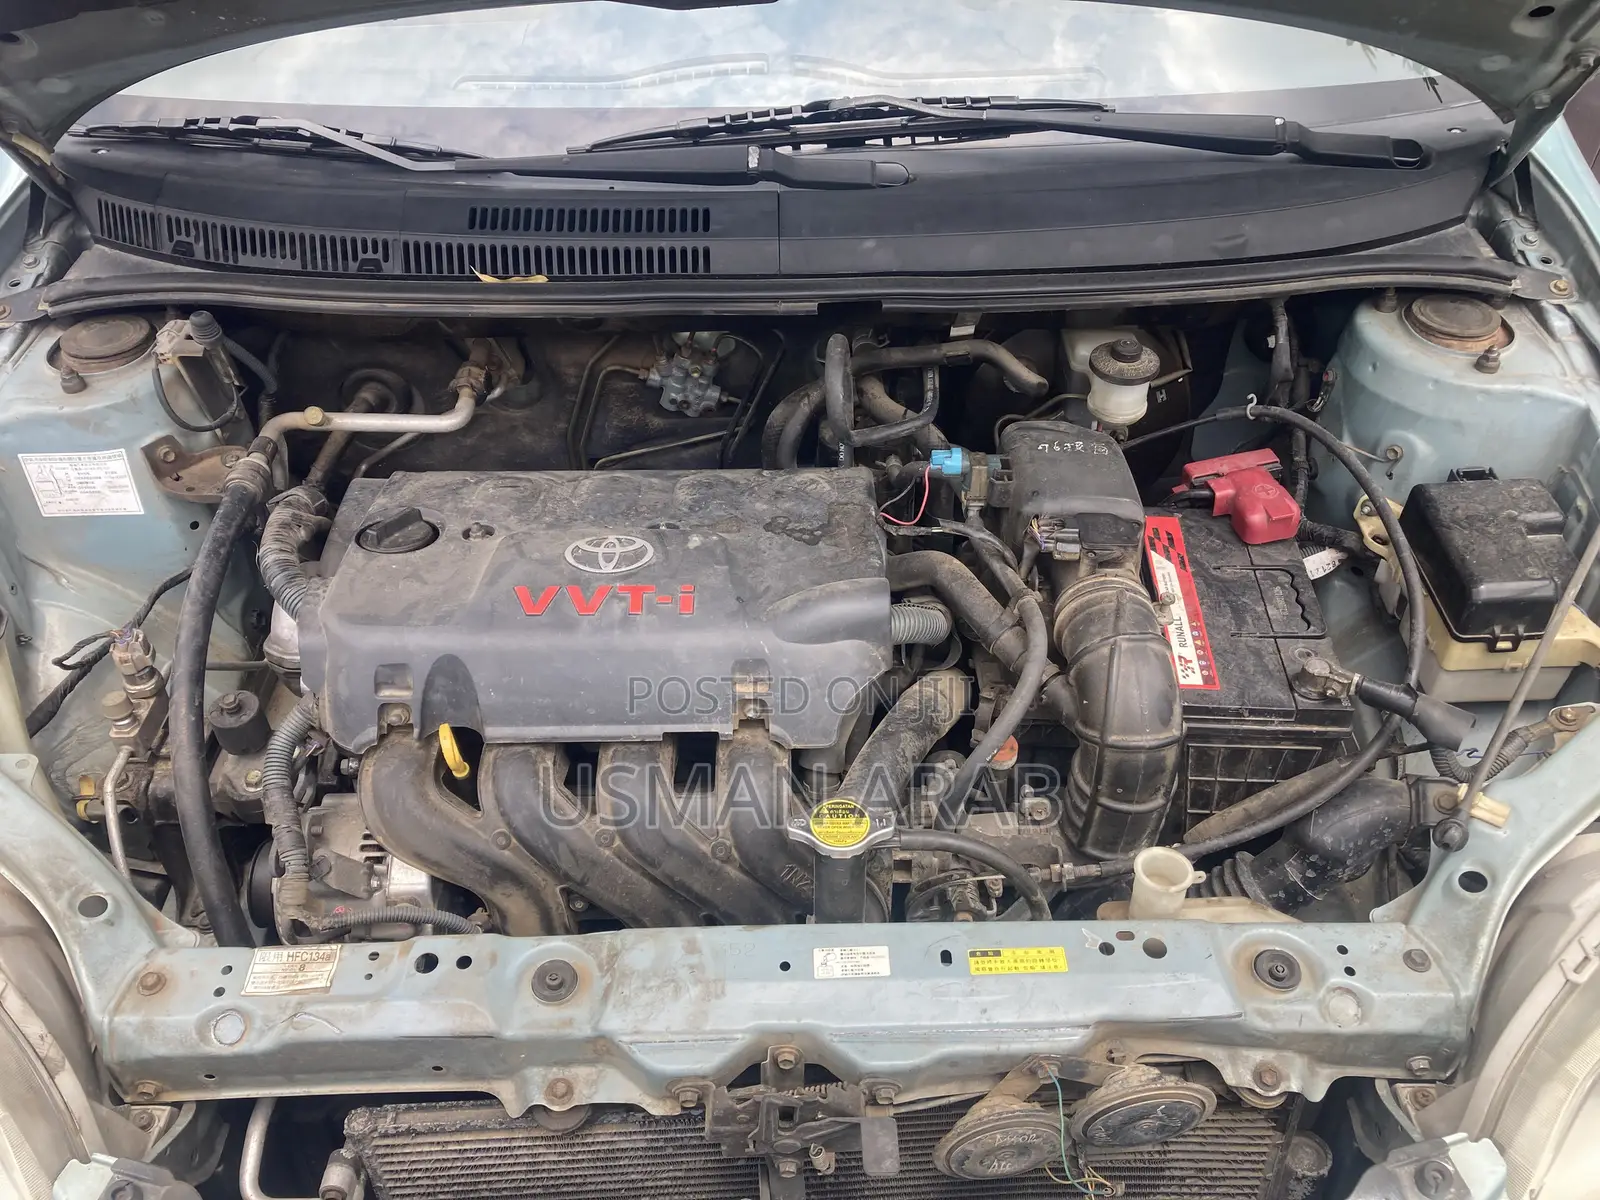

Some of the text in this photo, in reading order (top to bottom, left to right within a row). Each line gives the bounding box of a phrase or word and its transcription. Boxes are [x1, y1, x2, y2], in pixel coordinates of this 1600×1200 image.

[513, 585, 695, 616] VVT-i
[1175, 615, 1189, 649] RUNALL
[286, 951, 331, 962] HFC134a
